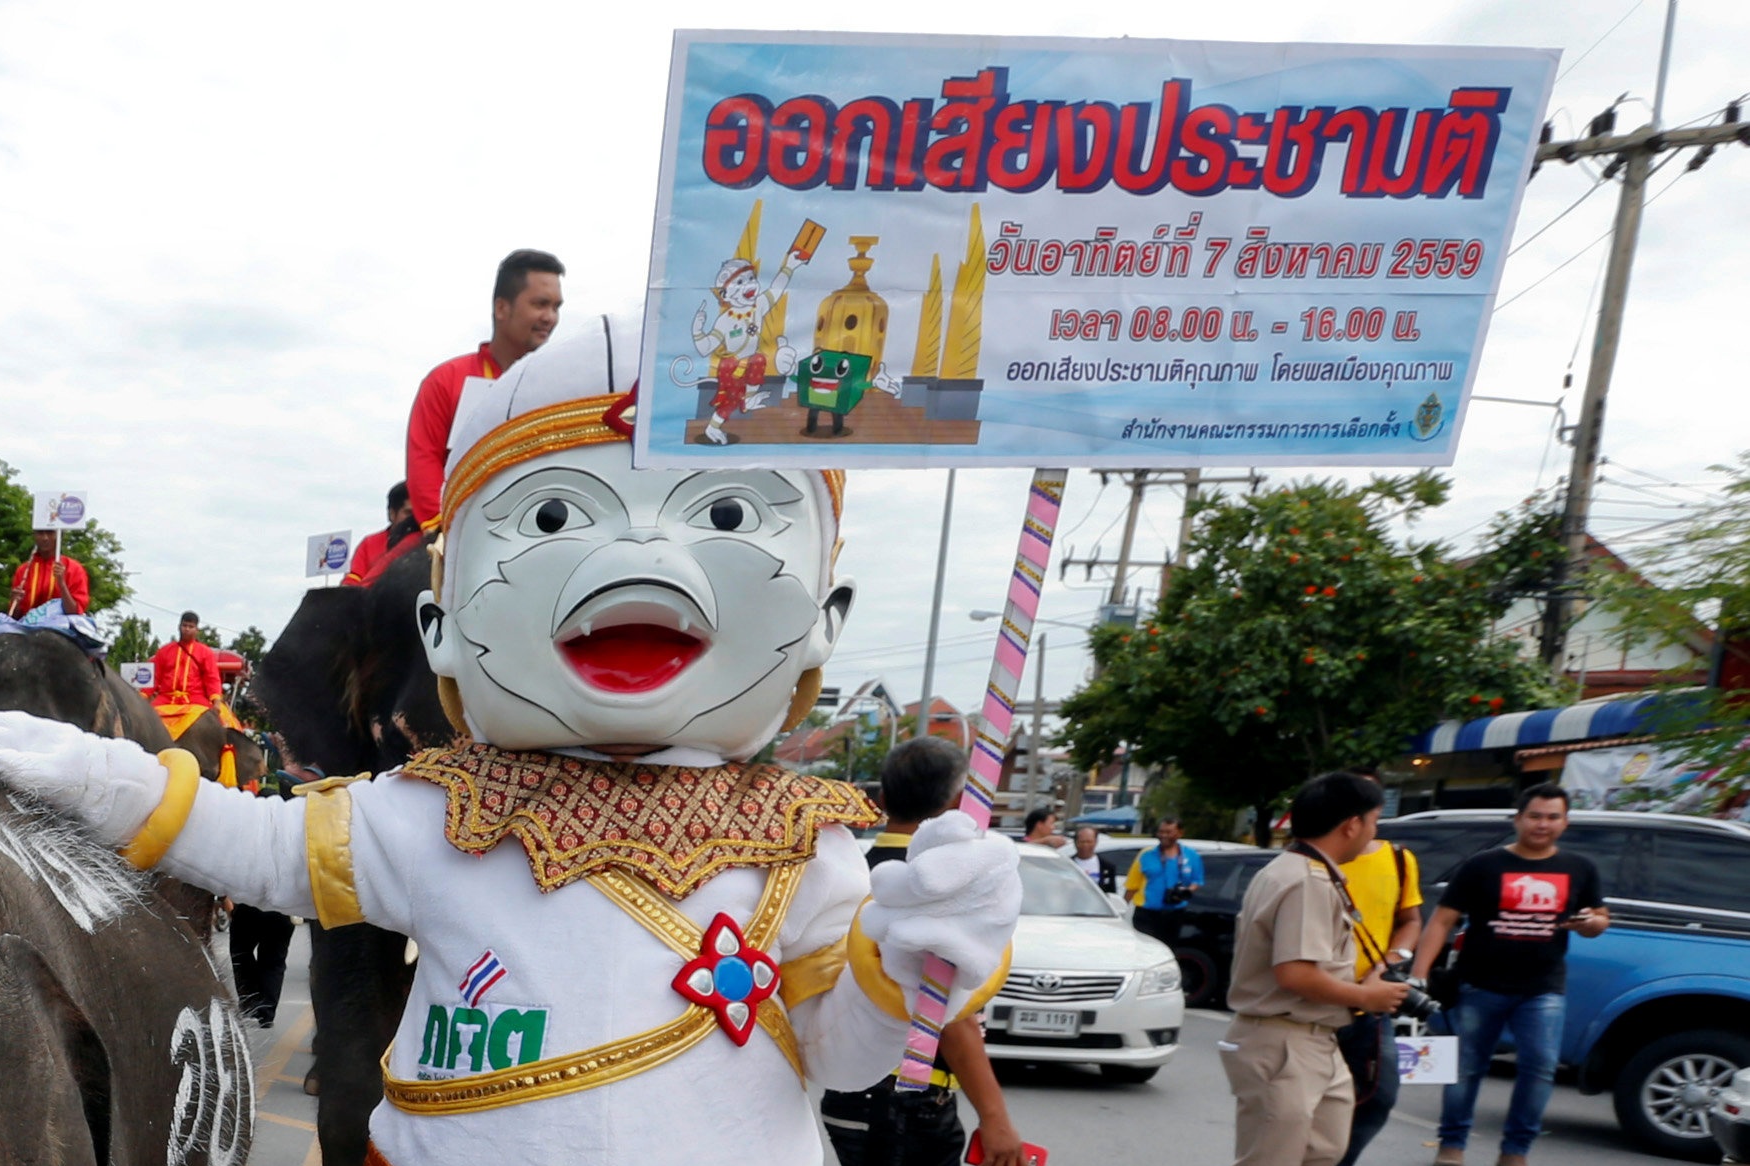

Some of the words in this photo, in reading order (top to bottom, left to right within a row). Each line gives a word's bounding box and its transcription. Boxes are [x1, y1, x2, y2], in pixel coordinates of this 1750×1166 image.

[702, 67, 1512, 199] ออกเสียงประชามติ
[986, 211, 1202, 276] วันอาทิตย์ที่
[1204, 238, 1231, 278] 7
[1234, 225, 1386, 278] สิงหาคม
[1388, 239, 1485, 280] 2559
[1049, 308, 1121, 341] เวลา
[1129, 306, 1223, 342] 08.00
[1231, 310, 1258, 342] น.
[1271, 322, 1288, 334] -
[1300, 307, 1385, 342] 16.00
[1392, 311, 1421, 342] น.
[1006, 357, 1257, 390] ออกเสียงประชามติคุณภาพ
[1269, 353, 1453, 390] โดยพลเมืองคุณภาพ
[1121, 411, 1400, 440] สำนักงานคณะกรรมการการเลือกตั้ง
